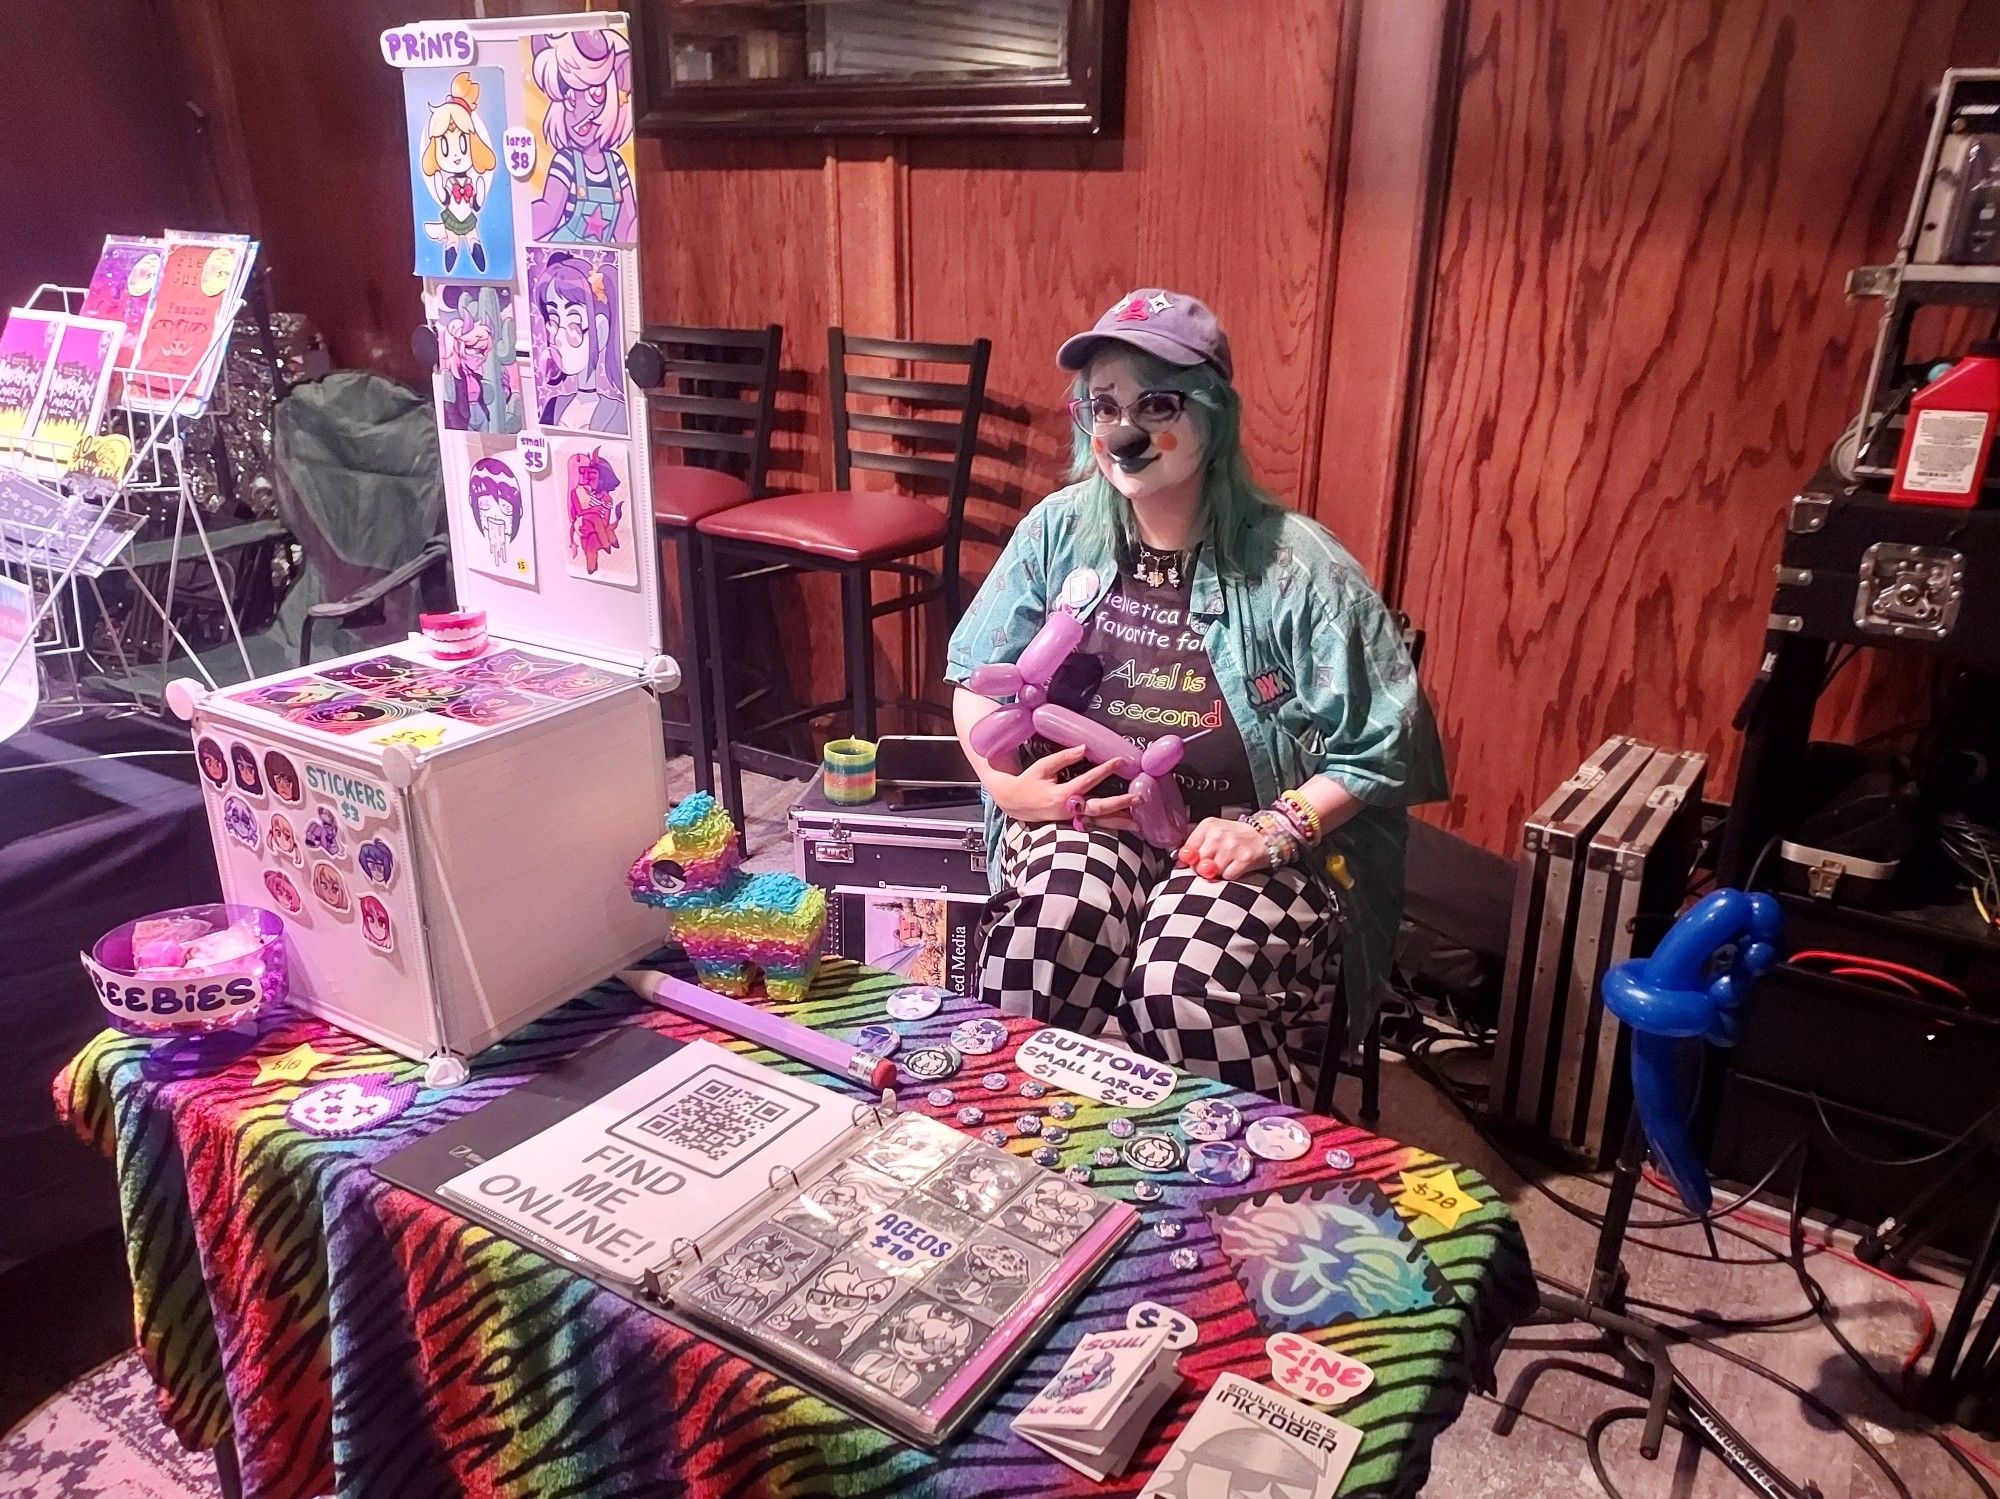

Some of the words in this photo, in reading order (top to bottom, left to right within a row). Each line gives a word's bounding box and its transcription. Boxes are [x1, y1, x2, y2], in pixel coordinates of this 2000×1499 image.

[506, 135, 532, 147] large
[511, 149, 529, 170] $8
[520, 437, 545, 448] small
[524, 449, 543, 468] $5
[1096, 611, 1170, 648] favorite
[1102, 658, 1181, 690] Arial
[1182, 669, 1206, 692] is
[1108, 699, 1222, 728] second
[305, 765, 387, 812] STICKERS
[341, 801, 360, 822] $3
[951, 926, 966, 971] Media
[1024, 1046, 1085, 1075] SMALL
[1091, 1071, 1159, 1101] LARGE
[1034, 1031, 1174, 1087] BUTTONS
[1033, 1064, 1057, 1078] $1
[1101, 1089, 1128, 1106] $4
[582, 1144, 687, 1196] FIND
[562, 1173, 640, 1214] ME
[1413, 1182, 1458, 1209] $20
[479, 1174, 656, 1264] ONLINE!
[875, 1213, 952, 1258] ACEOS
[870, 1235, 914, 1262] $10
[1281, 1366, 1335, 1398] $10
[1216, 1389, 1337, 1454] INKTOBER
[1228, 1383, 1338, 1439] SOULKILLUR'S
